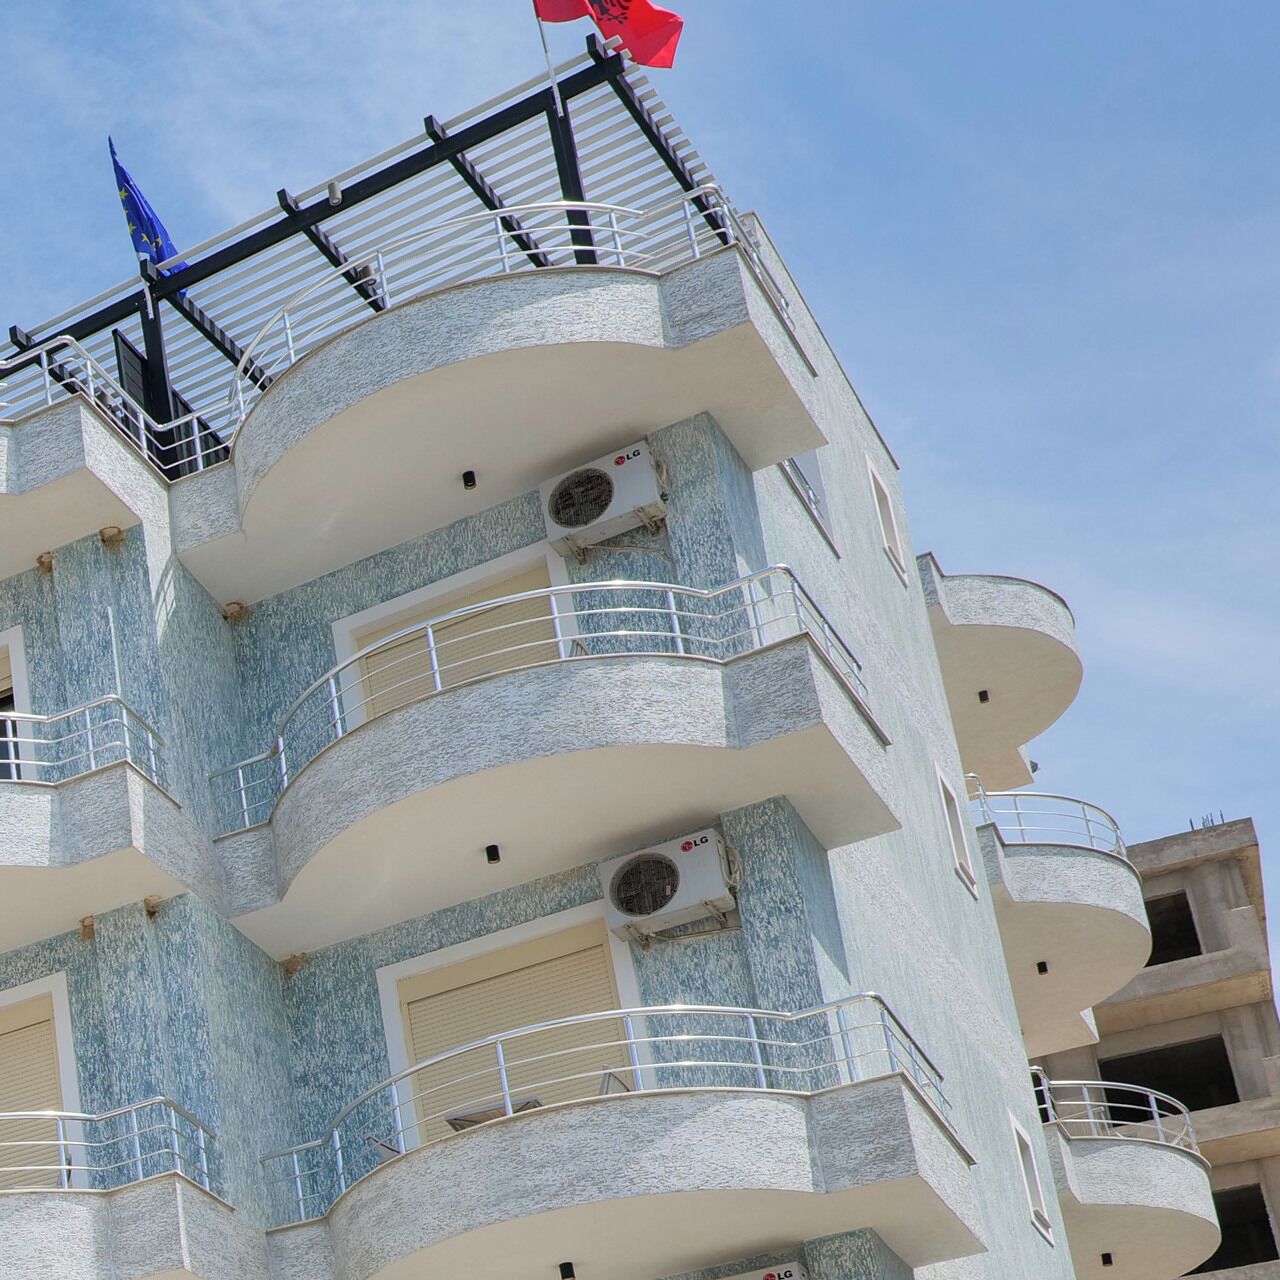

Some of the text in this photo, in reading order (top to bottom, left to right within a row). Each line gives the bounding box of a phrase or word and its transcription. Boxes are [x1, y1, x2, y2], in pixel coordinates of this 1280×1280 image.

[626, 449, 640, 460] LG
[693, 836, 709, 847] LG
[777, 1270, 793, 1280] LG
